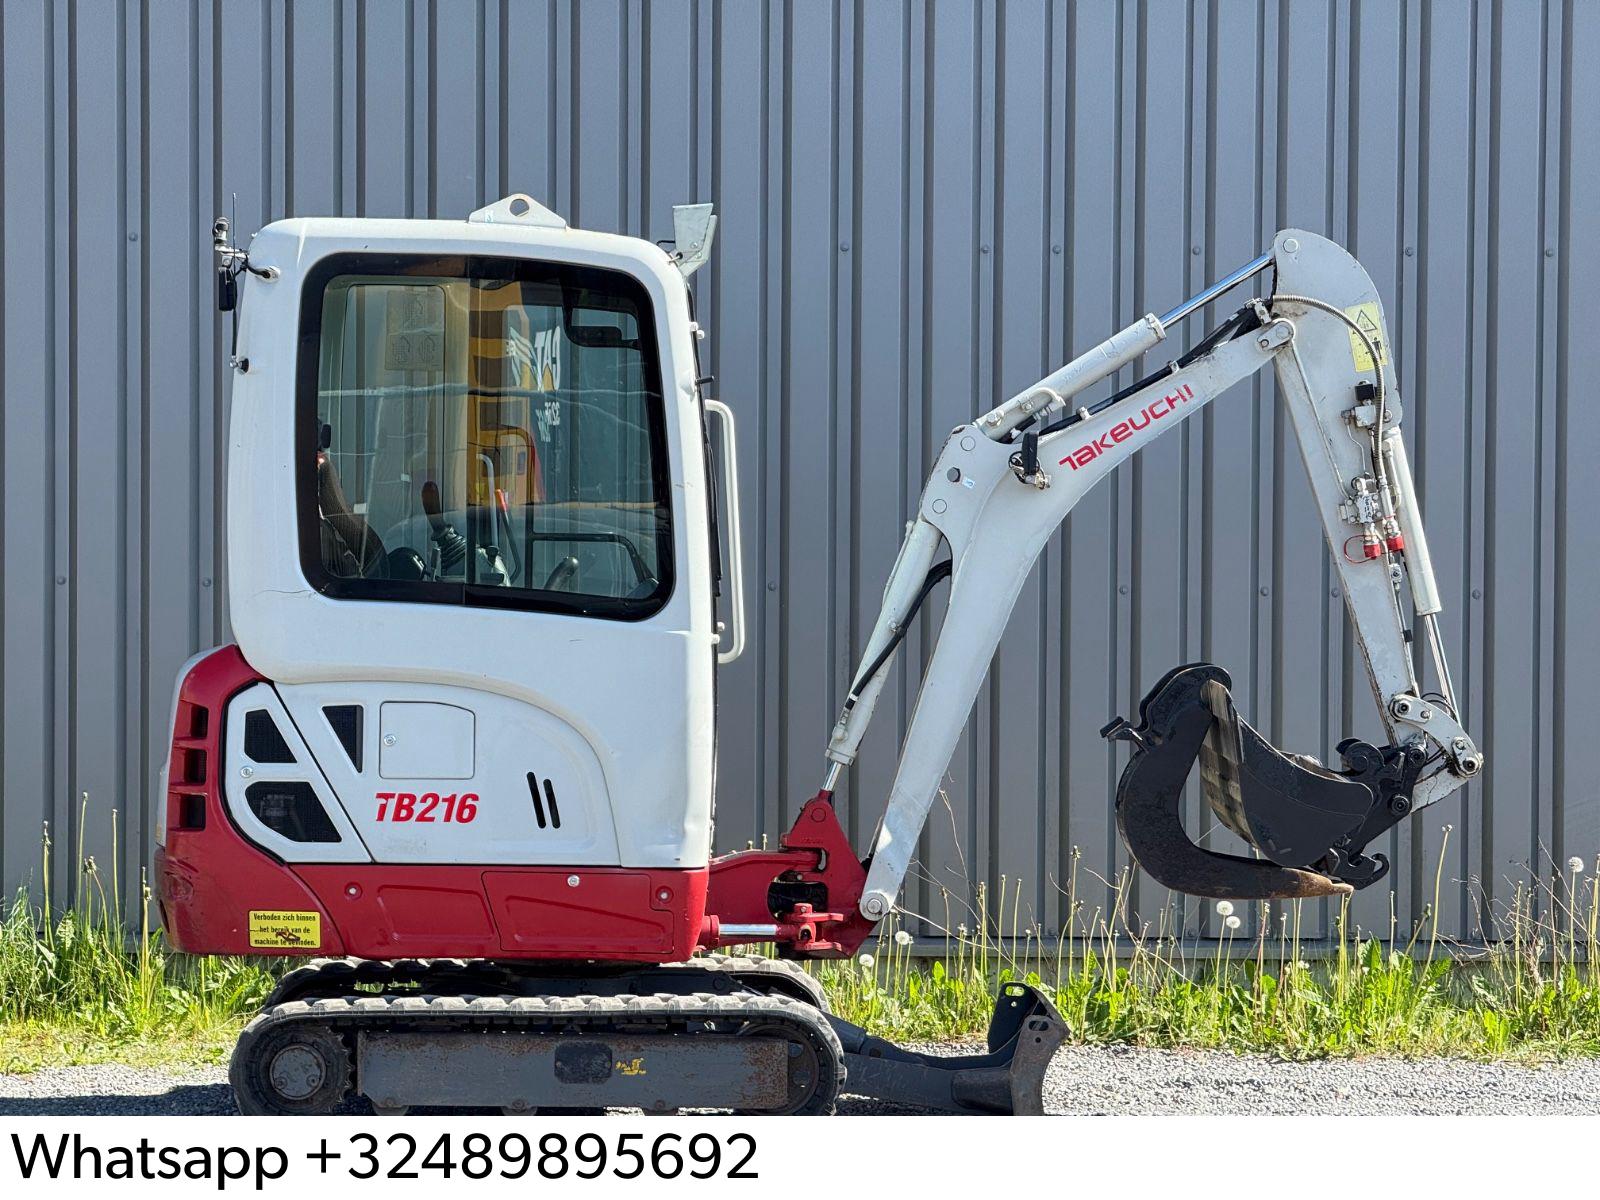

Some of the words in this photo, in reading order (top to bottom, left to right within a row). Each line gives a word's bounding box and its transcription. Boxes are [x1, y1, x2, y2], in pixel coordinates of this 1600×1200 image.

[1058, 384, 1194, 471] TAKEUCHI
[375, 792, 480, 824] TB216
[254, 913, 281, 921] Verboden
[282, 913, 295, 921] zich
[296, 914, 316, 922] binnen
[259, 925, 270, 933] het
[254, 937, 279, 945] machine
